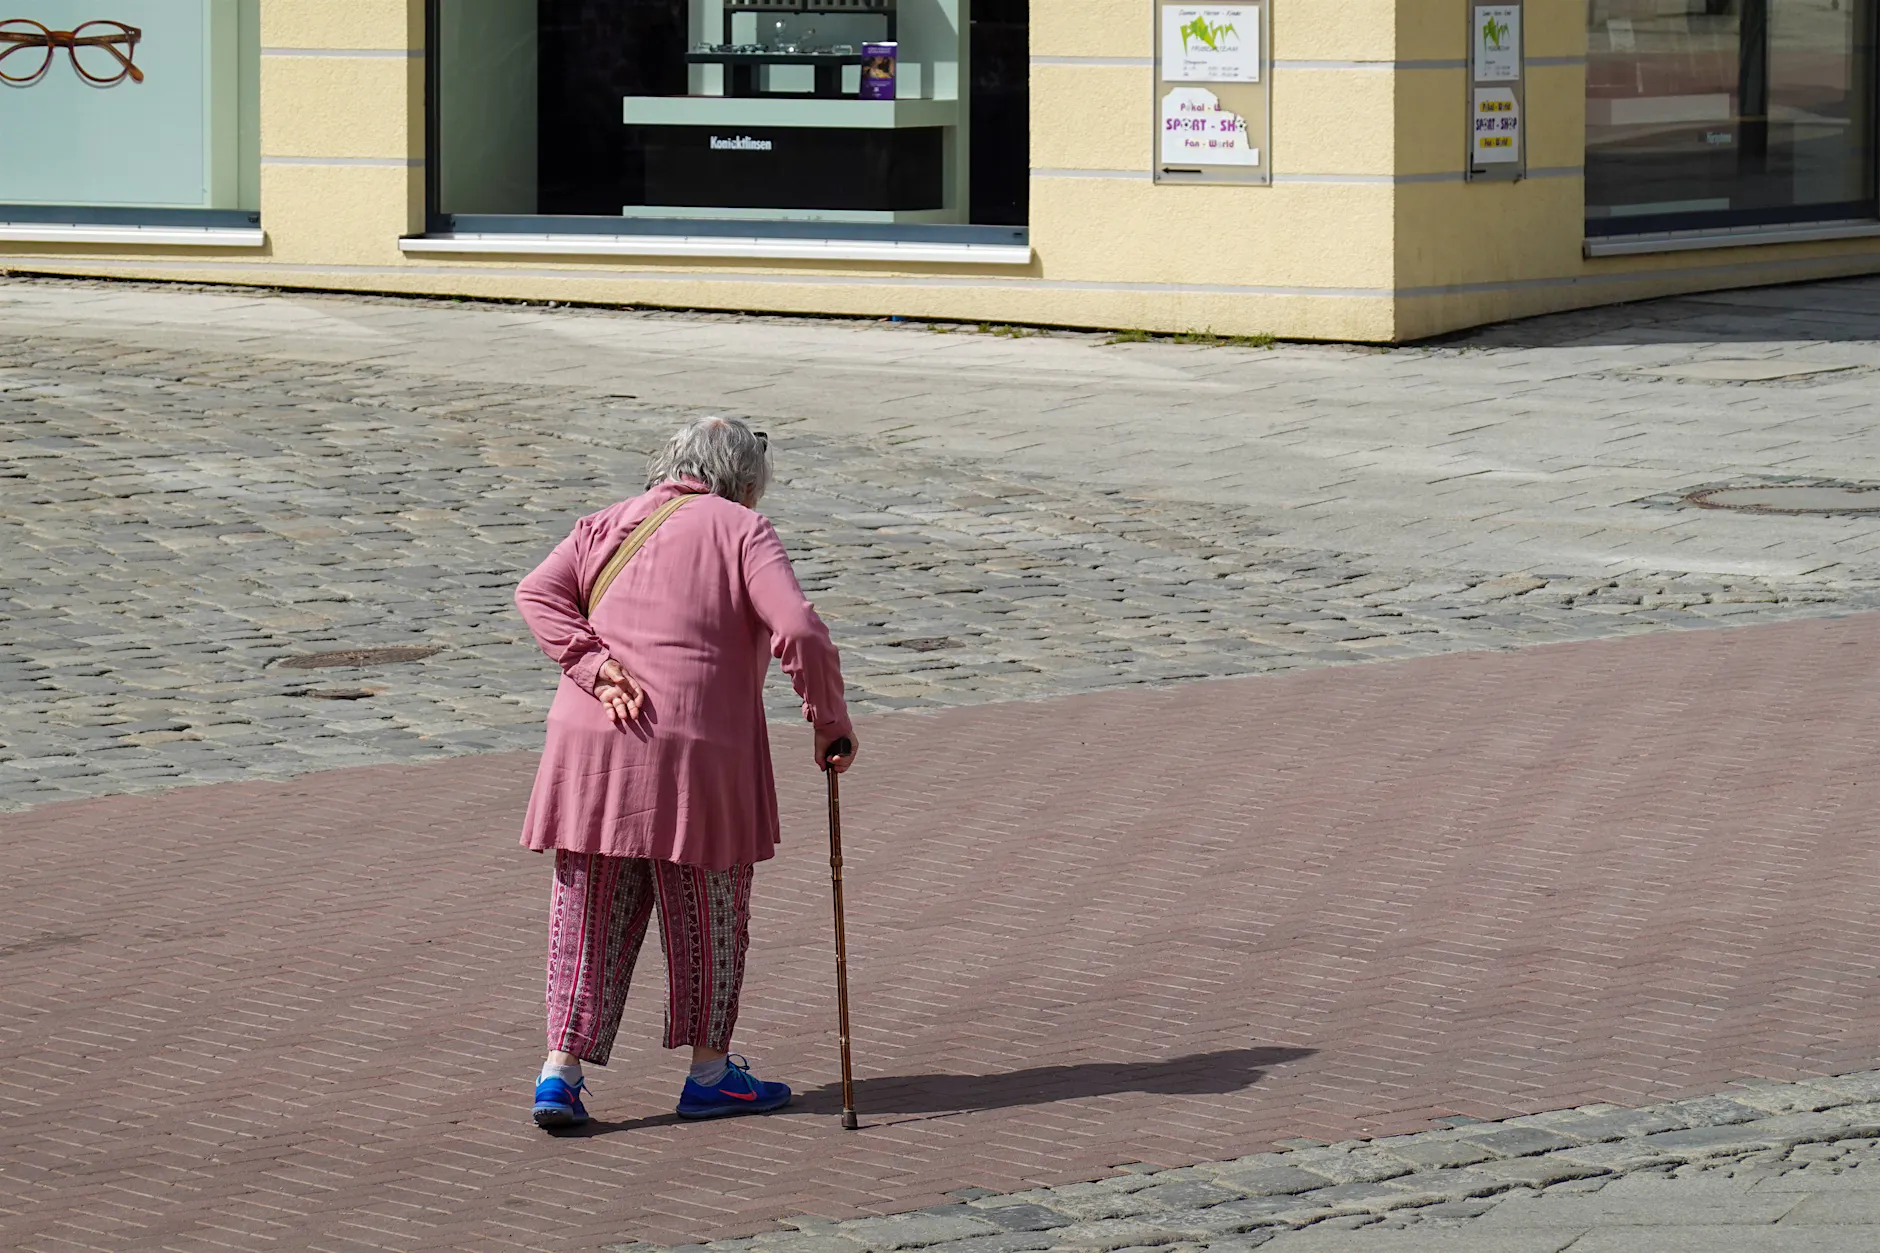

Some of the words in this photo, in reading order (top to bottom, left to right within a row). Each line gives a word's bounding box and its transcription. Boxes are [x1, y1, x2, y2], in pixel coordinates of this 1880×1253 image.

[1166, 118, 1207, 131] SPORT
[1220, 119, 1247, 132] SHO
[1184, 139, 1200, 147] Fan
